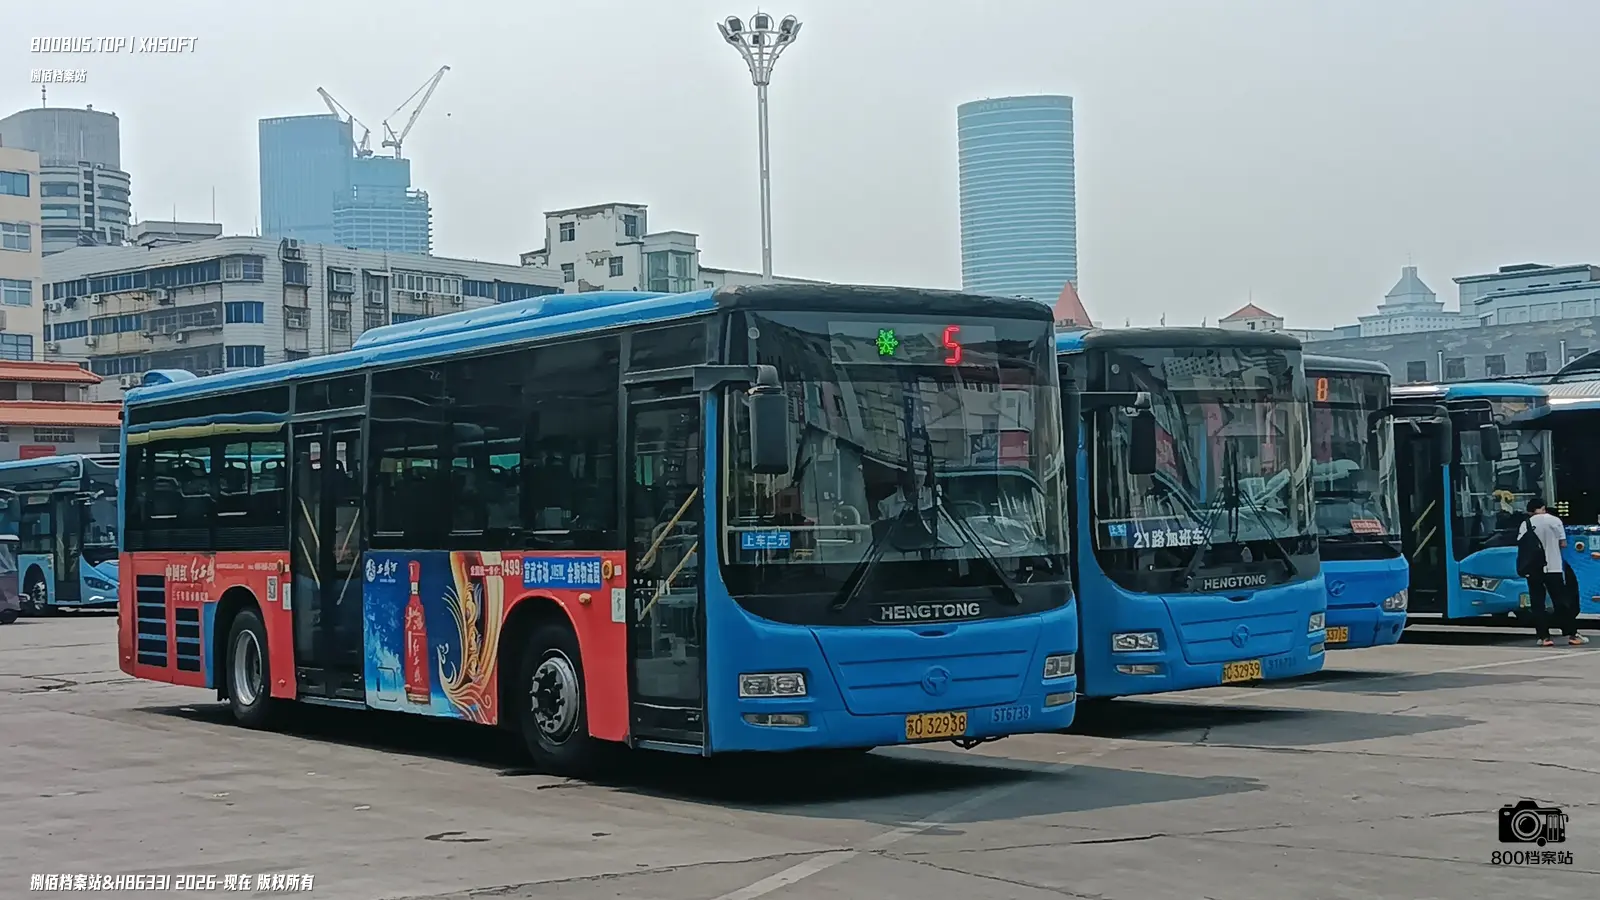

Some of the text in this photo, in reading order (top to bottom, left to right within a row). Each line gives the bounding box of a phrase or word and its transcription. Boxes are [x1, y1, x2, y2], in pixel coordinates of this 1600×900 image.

[943, 325, 961, 365] 5
[1317, 377, 1328, 402] 8
[743, 534, 789, 547] 上车二元
[1133, 528, 1204, 549] 21路加班车
[1204, 575, 1267, 590] HENGTONG
[881, 602, 980, 621] HENGTONG
[993, 706, 1030, 722] ST6738
